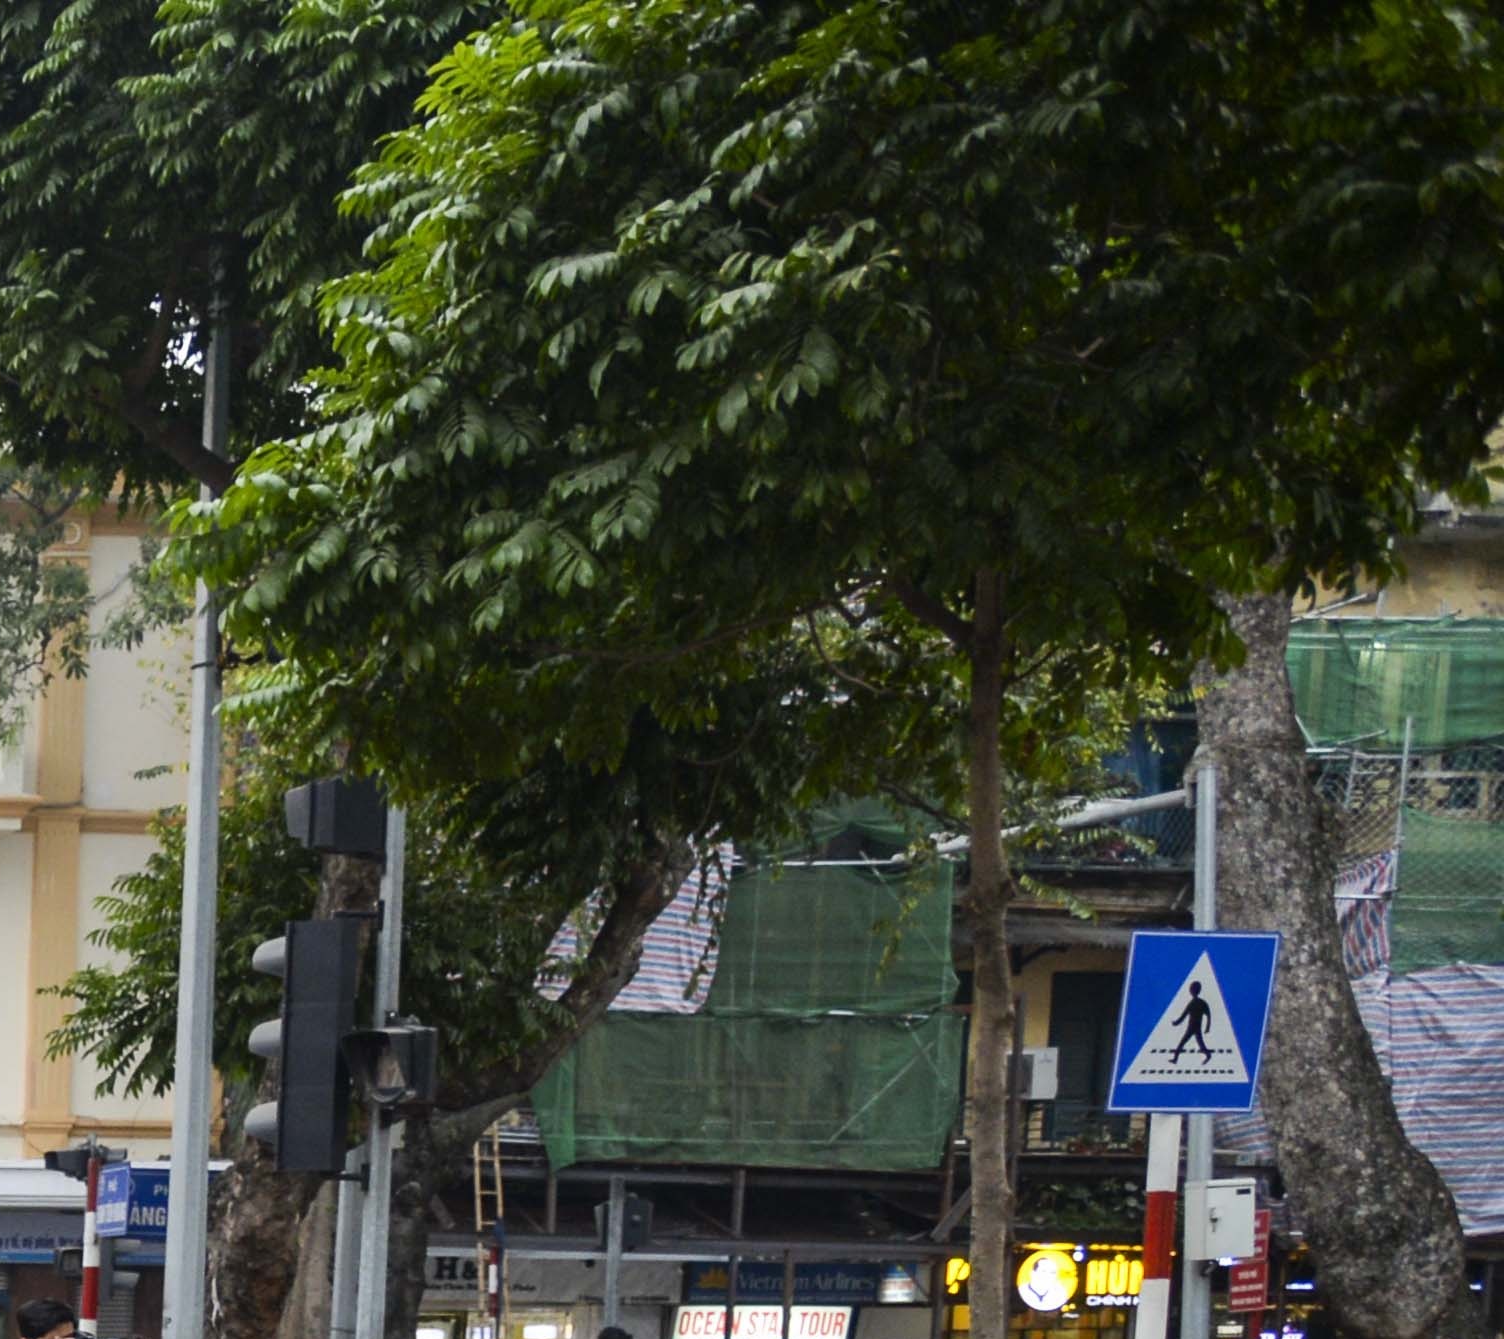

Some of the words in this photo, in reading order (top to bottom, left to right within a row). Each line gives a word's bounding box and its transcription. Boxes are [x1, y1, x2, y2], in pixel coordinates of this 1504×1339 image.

[737, 1272, 810, 1289] Vietnm
[813, 1271, 875, 1290] Airlines
[678, 1310, 743, 1336] OCEAN
[747, 1311, 784, 1336] STA
[799, 1311, 846, 1336] TOUR
